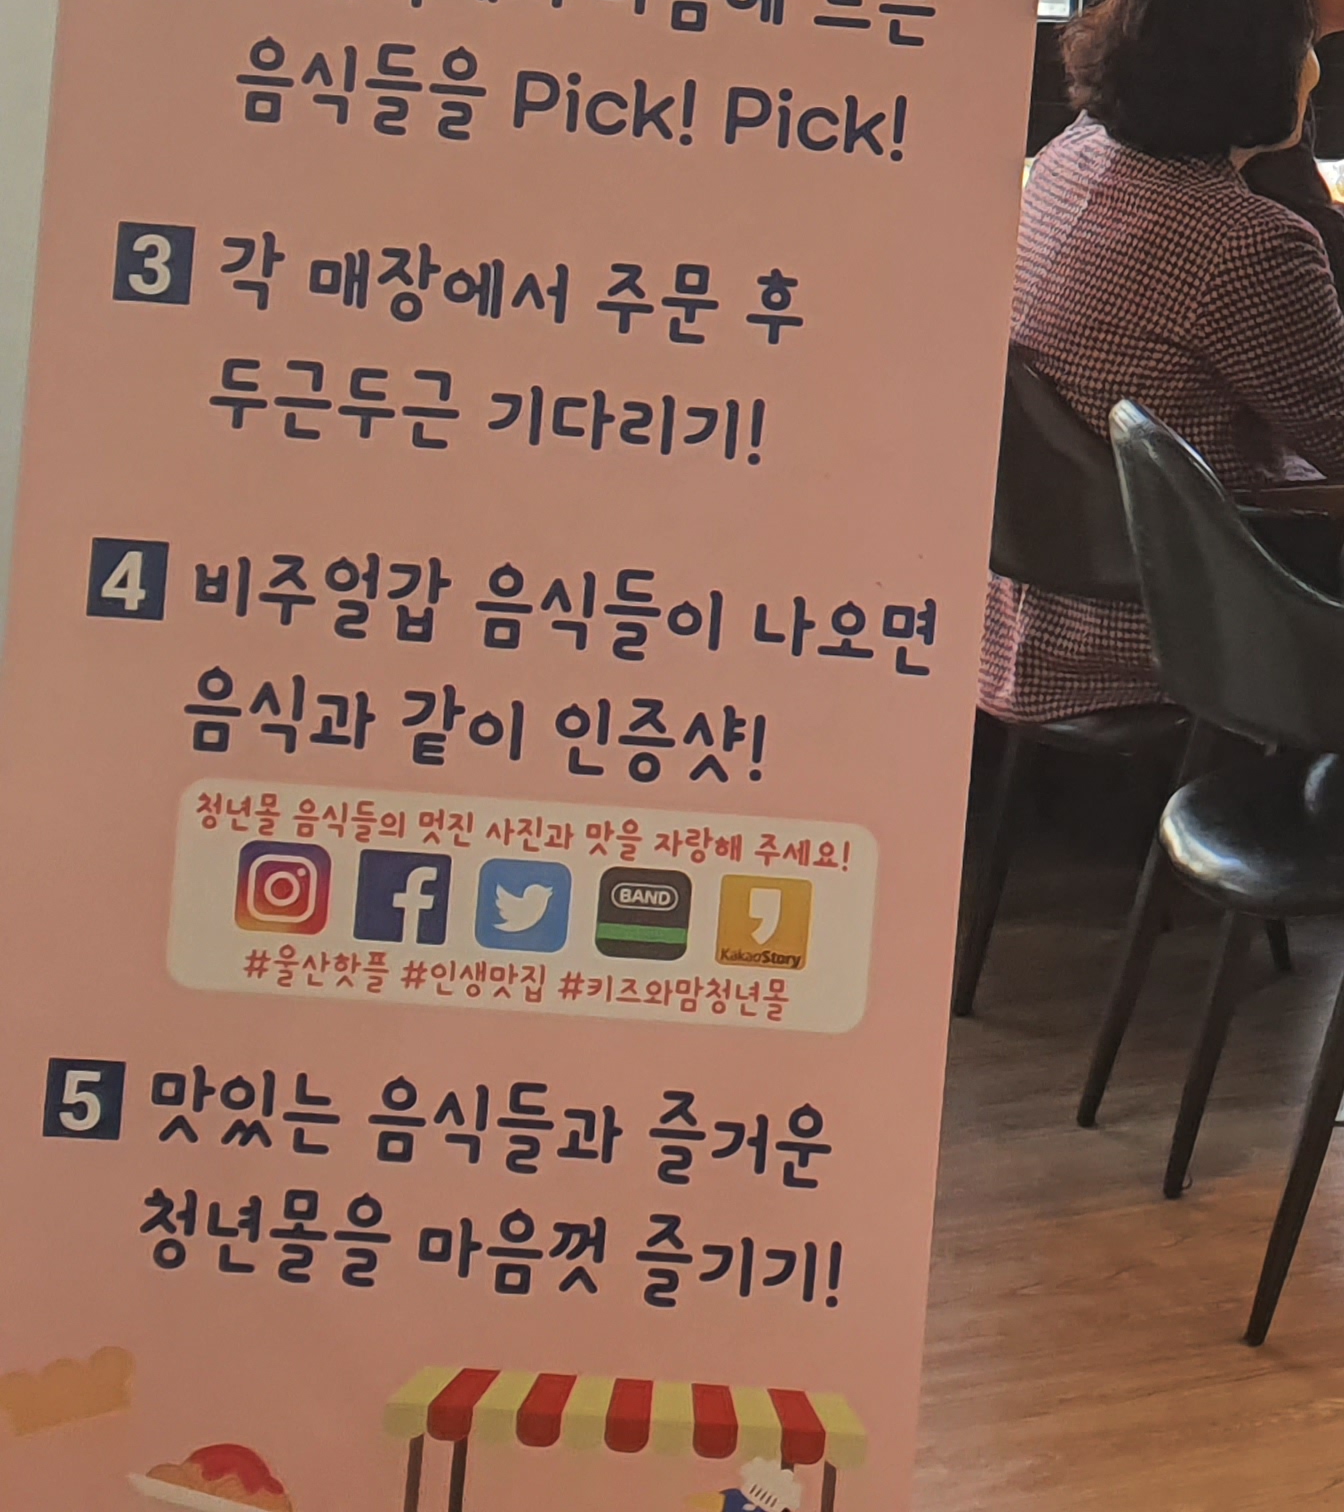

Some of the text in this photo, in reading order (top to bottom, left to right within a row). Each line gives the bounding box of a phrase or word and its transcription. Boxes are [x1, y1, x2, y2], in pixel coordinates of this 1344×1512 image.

[236, 35, 909, 163] 음식들을 Pick! Pick!
[127, 230, 804, 345] 3 각 매장에서 주문 후
[209, 356, 767, 467] 두근두근 기다리기!
[100, 550, 939, 678] 4 비주얼갑 음식들이 나오면
[183, 665, 767, 784] 음식과 같이 인증샷!
[195, 790, 852, 873] 청년몰 음식들의 멋진 사진과 맛을 자랑해 주세요!
[619, 887, 671, 907] BAND
[243, 943, 789, 1023] #울산핫플 #인생맛집 #키즈와맘청년몰
[719, 947, 802, 970] KakaoStory
[58, 1064, 833, 1190] 5 맛있는 음식들과 즐거운
[139, 1188, 844, 1309] 청년몰을 마음껏 즐기기!
